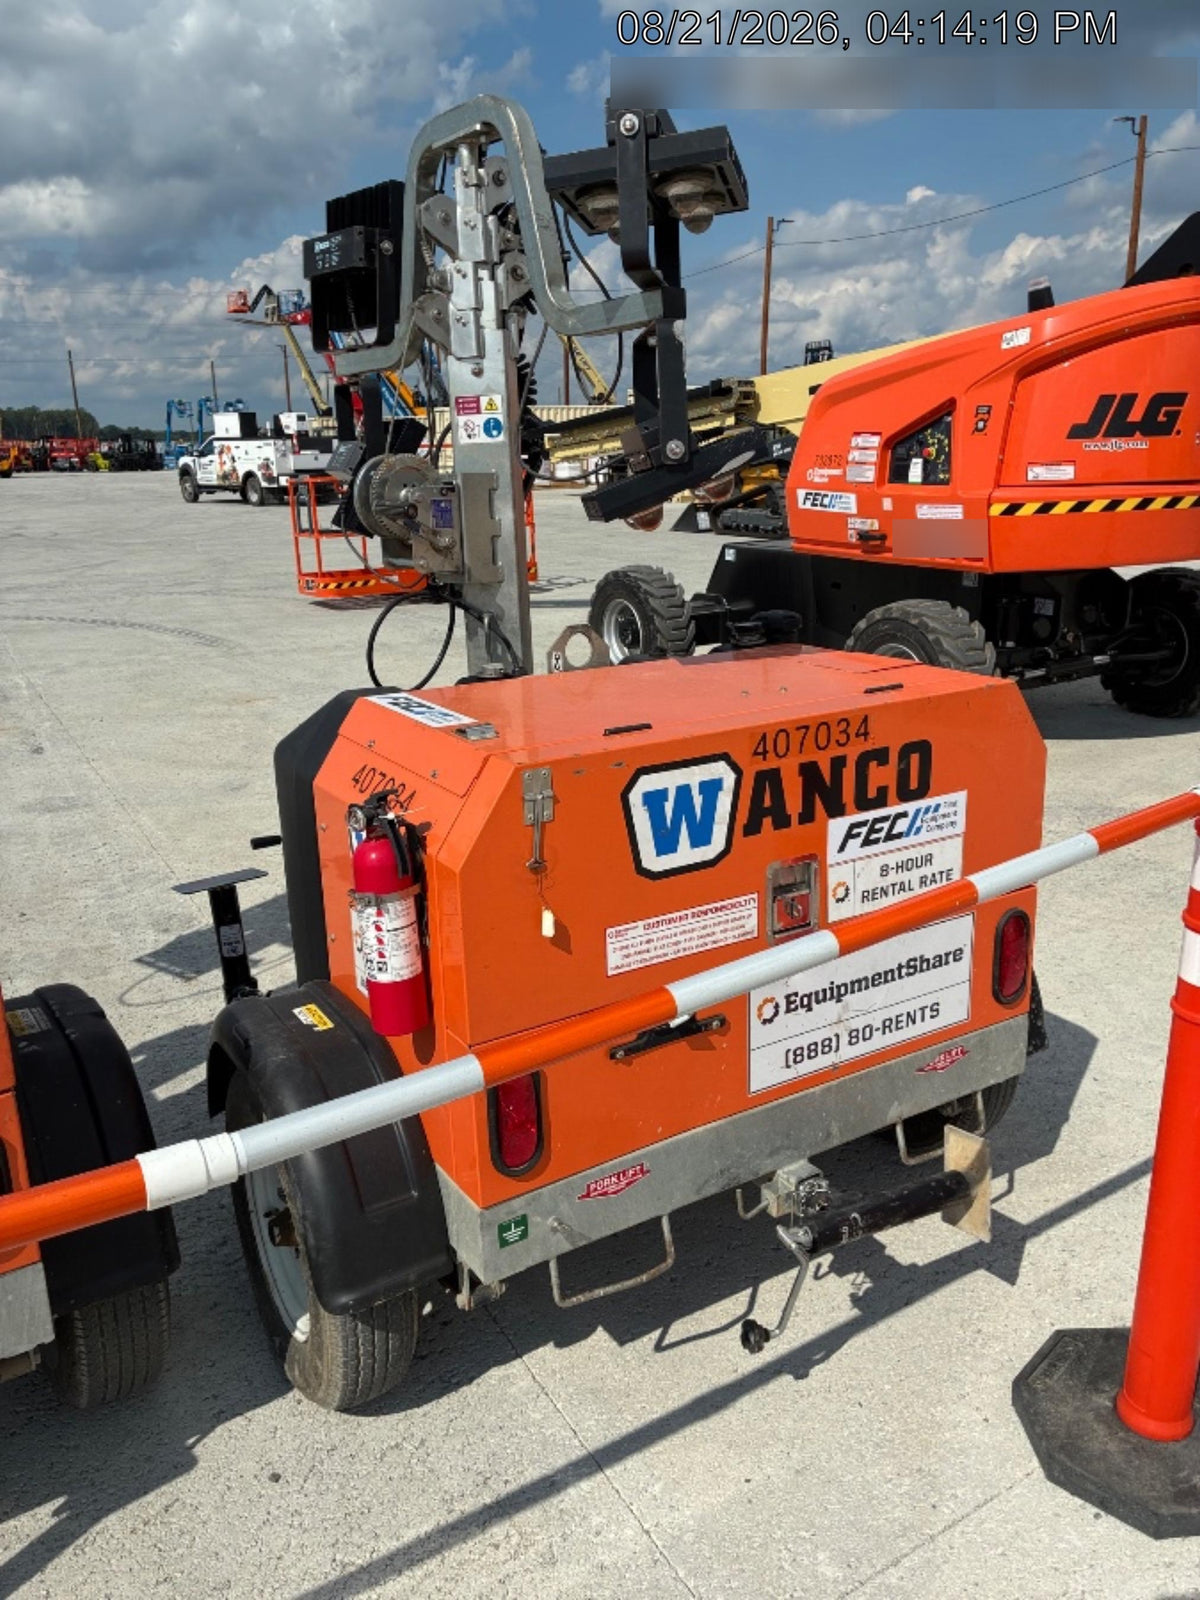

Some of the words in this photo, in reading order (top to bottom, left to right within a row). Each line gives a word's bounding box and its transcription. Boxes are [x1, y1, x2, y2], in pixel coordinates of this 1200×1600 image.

[1066, 392, 1188, 440] JLG
[1083, 439, 1149, 452] www.jlg.com
[802, 491, 830, 509] FEC
[751, 714, 871, 762] 407034
[836, 810, 909, 854] FEC
[861, 880, 915, 904] RENTAL
[918, 868, 954, 886] RATE
[880, 852, 934, 878] 8-HOUR
[783, 946, 965, 1014] EquipmentShare
[785, 1033, 841, 1069] (888)
[847, 1001, 942, 1047] 80-RENTS
